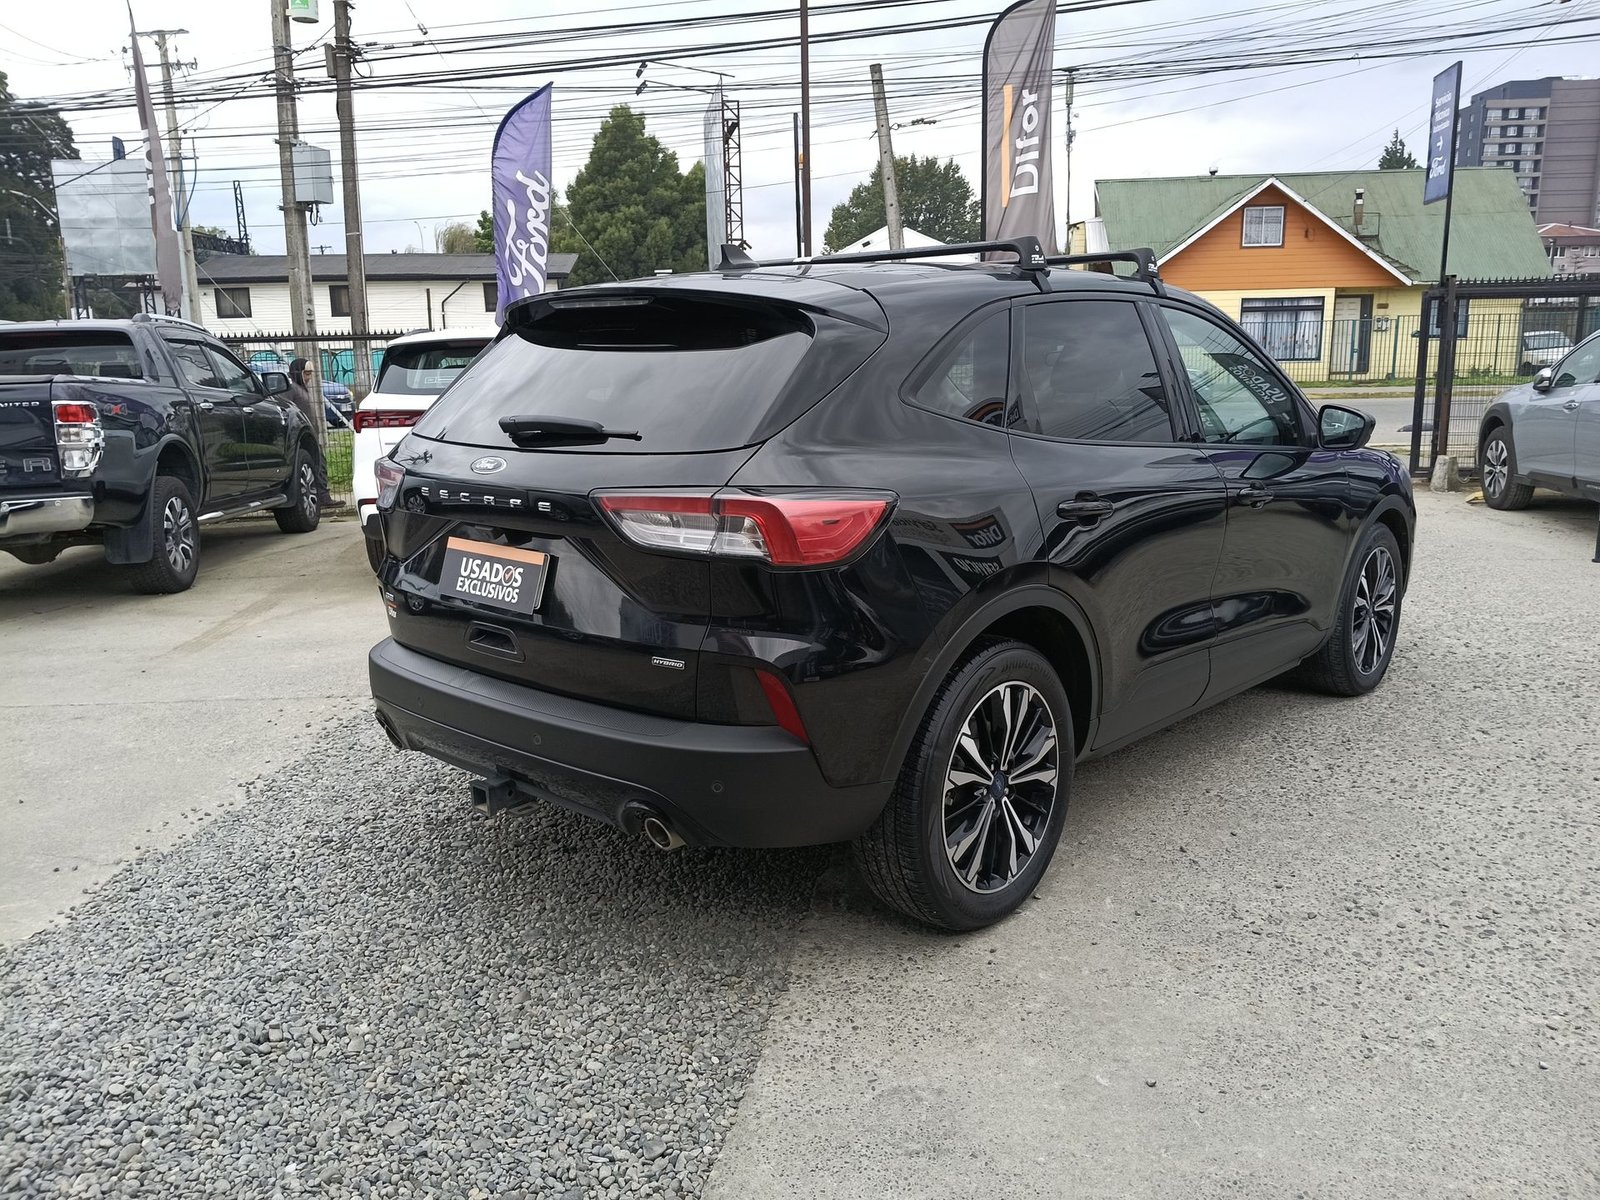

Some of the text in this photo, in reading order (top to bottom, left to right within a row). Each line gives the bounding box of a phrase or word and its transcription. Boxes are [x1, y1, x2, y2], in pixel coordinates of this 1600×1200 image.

[1429, 155, 1447, 179] Ford
[506, 170, 551, 298] Ford
[459, 556, 524, 587] USADOS
[455, 576, 520, 604] EXCLUSIVOS
[653, 658, 684, 669] HYBRID
